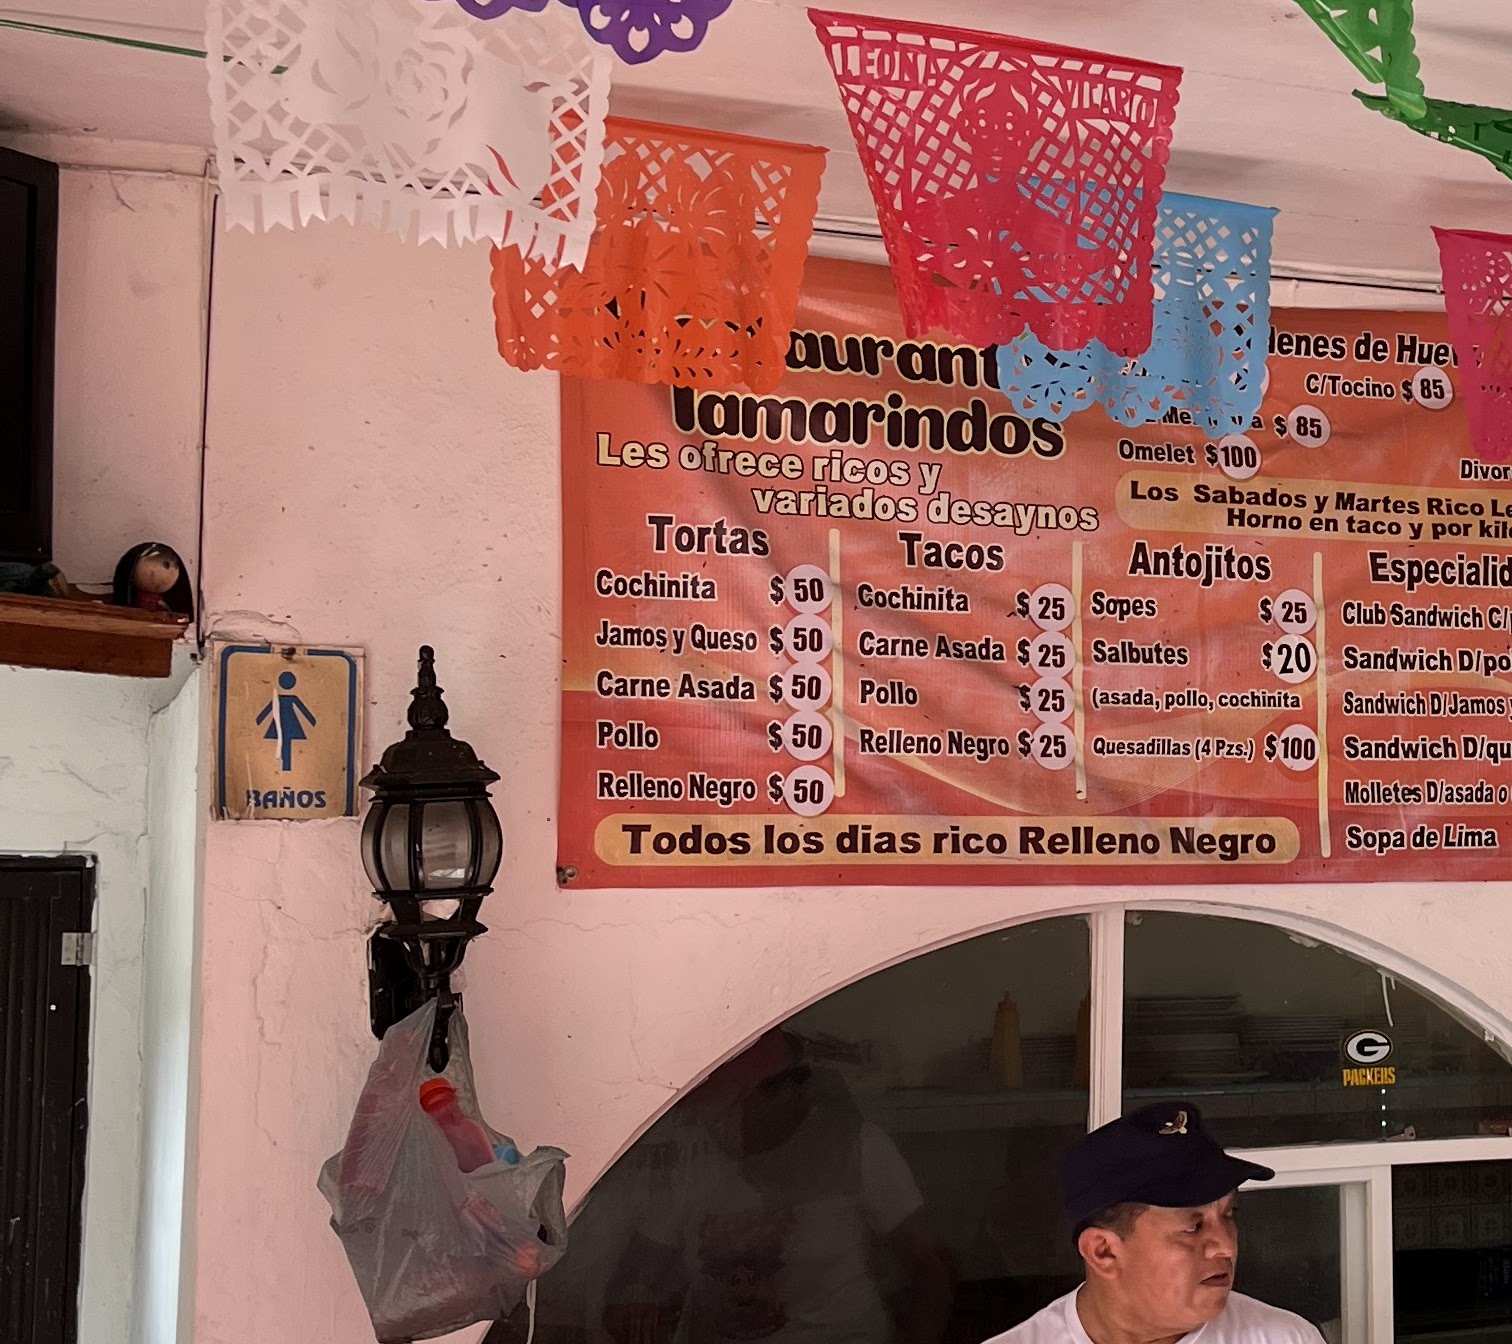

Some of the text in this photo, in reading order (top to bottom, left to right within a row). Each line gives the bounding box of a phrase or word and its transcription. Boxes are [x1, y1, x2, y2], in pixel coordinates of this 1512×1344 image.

[786, 330, 1002, 390] aurant
[1355, 332, 1388, 361] de
[1305, 373, 1394, 399] C/Tocino
[596, 431, 942, 493] Les ofrece ricos y
[1119, 440, 1195, 463] Omelet
[752, 486, 1098, 535] variados desaynos
[1131, 482, 1178, 502] Los
[1194, 485, 1306, 508] Sabados
[1315, 493, 1328, 514] y
[1335, 493, 1420, 515] Martes
[1427, 497, 1484, 517] Rico
[648, 515, 770, 557] Tortas
[1227, 508, 1300, 531] Horno
[1310, 516, 1338, 532] en
[1347, 517, 1400, 536] taco
[1409, 522, 1422, 540] y
[1432, 522, 1470, 541] por
[900, 534, 1005, 572] Tacos
[1129, 542, 1271, 587] Antojitos
[596, 570, 716, 601] Cochinita
[858, 584, 969, 612] Cochinita
[1091, 591, 1157, 621] Sopes
[1342, 602, 1386, 627] Club
[1390, 605, 1484, 630] Sandwich
[596, 621, 757, 654] Jamos y Queso
[858, 631, 1005, 662] Carne Asada
[1093, 639, 1188, 665] Salbutes
[1092, 688, 1300, 710] (asada, pollo, cochinita
[1093, 737, 1190, 756] Quesadillas
[246, 787, 326, 809] BAÑOS
[598, 773, 756, 804] Relleno Negro
[622, 824, 1276, 860] Todos los dias rico Relleno Negro
[1342, 1067, 1396, 1086] PACKERS
